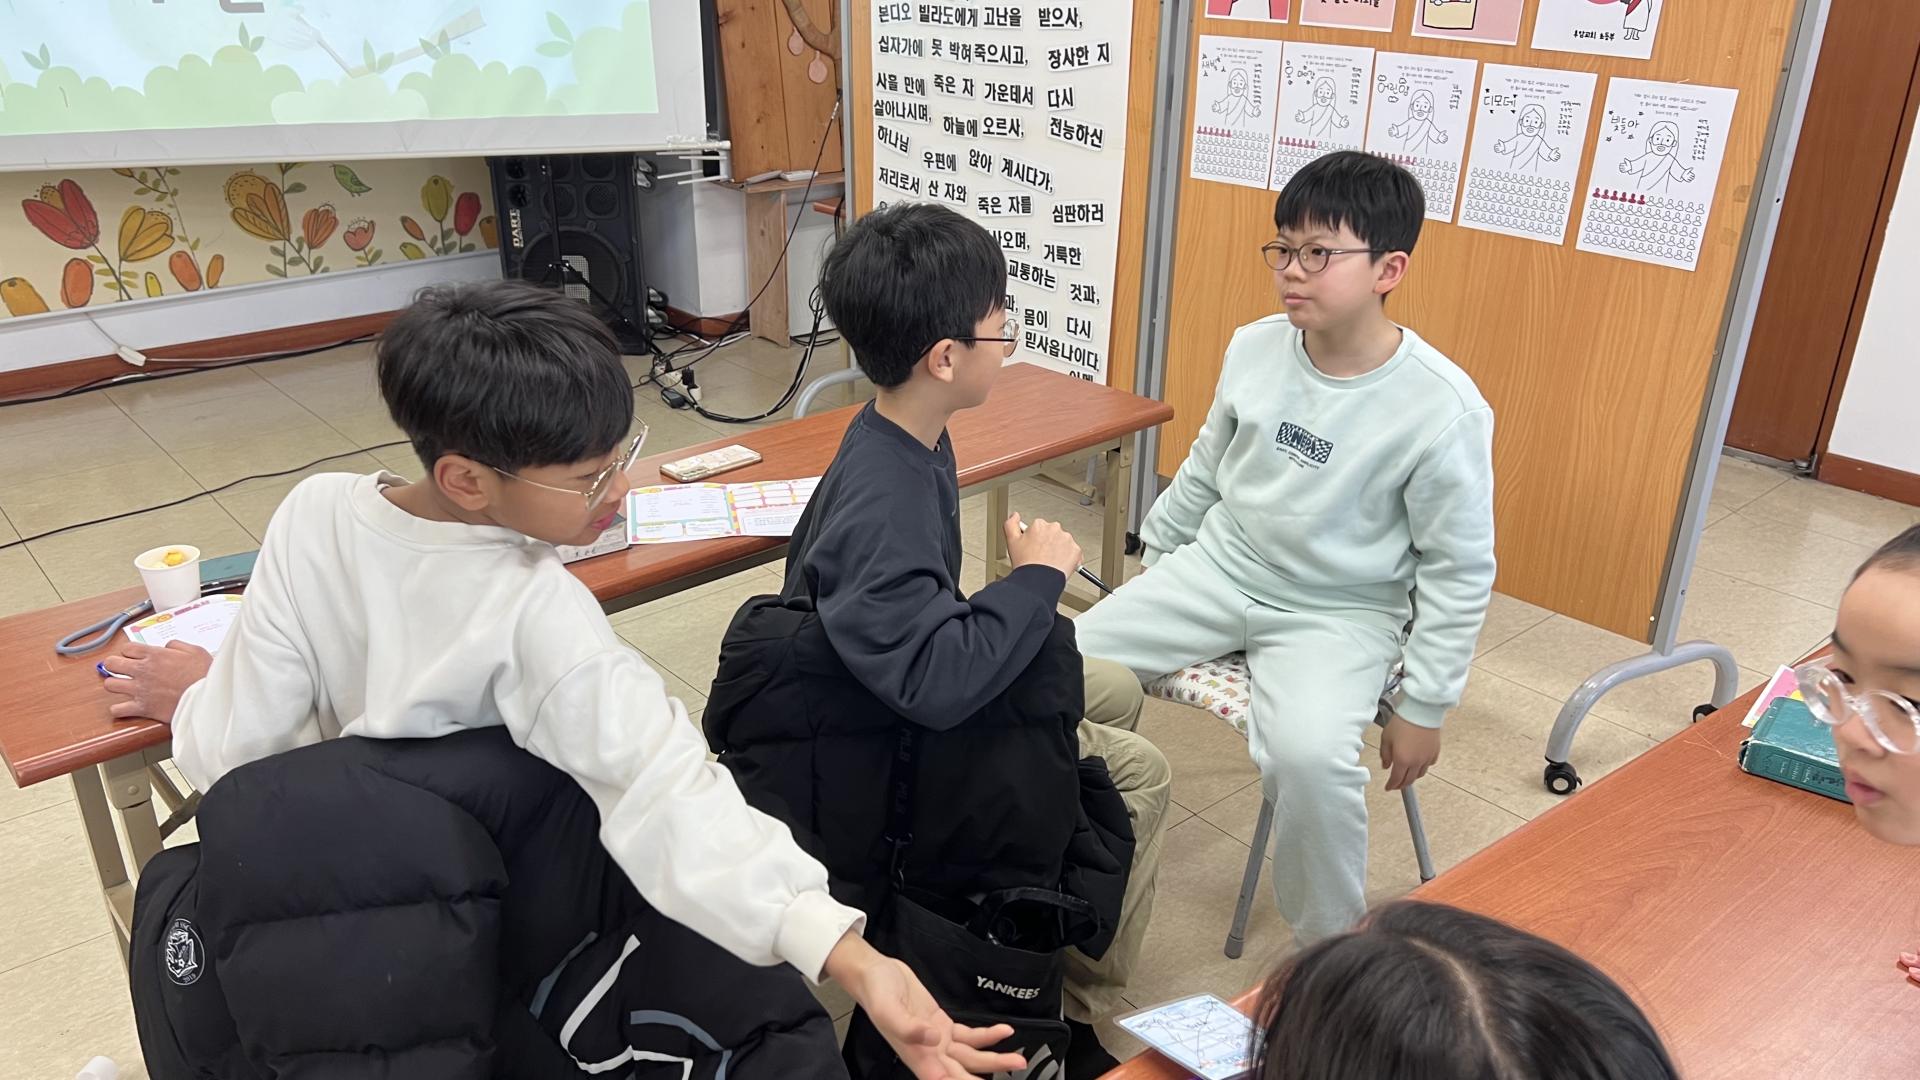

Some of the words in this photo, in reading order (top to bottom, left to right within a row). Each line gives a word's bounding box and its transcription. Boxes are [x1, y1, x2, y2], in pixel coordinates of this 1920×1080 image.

[879, 3, 912, 23] 본디오
[919, 5, 977, 27] 빌라도에게
[984, 7, 1022, 26] 고난을
[1039, 7, 1083, 28] 받으사,
[879, 35, 923, 57] 십자가에
[931, 39, 942, 57] 못
[974, 44, 1028, 64] 죽으시고,
[1048, 46, 1088, 69] 장사한
[1098, 43, 1110, 62] 지
[876, 73, 897, 91] 사흘
[905, 76, 925, 95] 만에
[934, 75, 956, 94] 죽은
[963, 78, 974, 96] 자
[1048, 87, 1074, 107] 다시
[1484, 95, 1516, 107] 디모데
[874, 100, 931, 122] 살아나시며,
[944, 116, 977, 136] 하늘에
[983, 117, 1024, 137] 오르사,
[1050, 117, 1103, 148] 전능하신
[878, 125, 910, 152] 하나님
[924, 152, 957, 171] 우편에
[969, 149, 992, 172] 앉아
[1001, 157, 1053, 191] 계시다가,
[879, 166, 920, 194] 저리로서
[928, 180, 939, 197] 산
[945, 183, 967, 202] 자와
[978, 196, 1002, 214] 죽은
[1009, 196, 1032, 214] 자를
[1052, 204, 1104, 223] 심판하러
[510, 209, 520, 247] DART
[1044, 244, 1081, 265] 거룩한
[1008, 260, 1056, 288] 교통하는
[1070, 283, 1100, 304] 것과,
[1025, 309, 1047, 328] 몸이
[1066, 317, 1091, 339] 다시
[1025, 332, 1099, 371] 믿사옵나이다.
[976, 975, 1041, 1000] YANKEES
